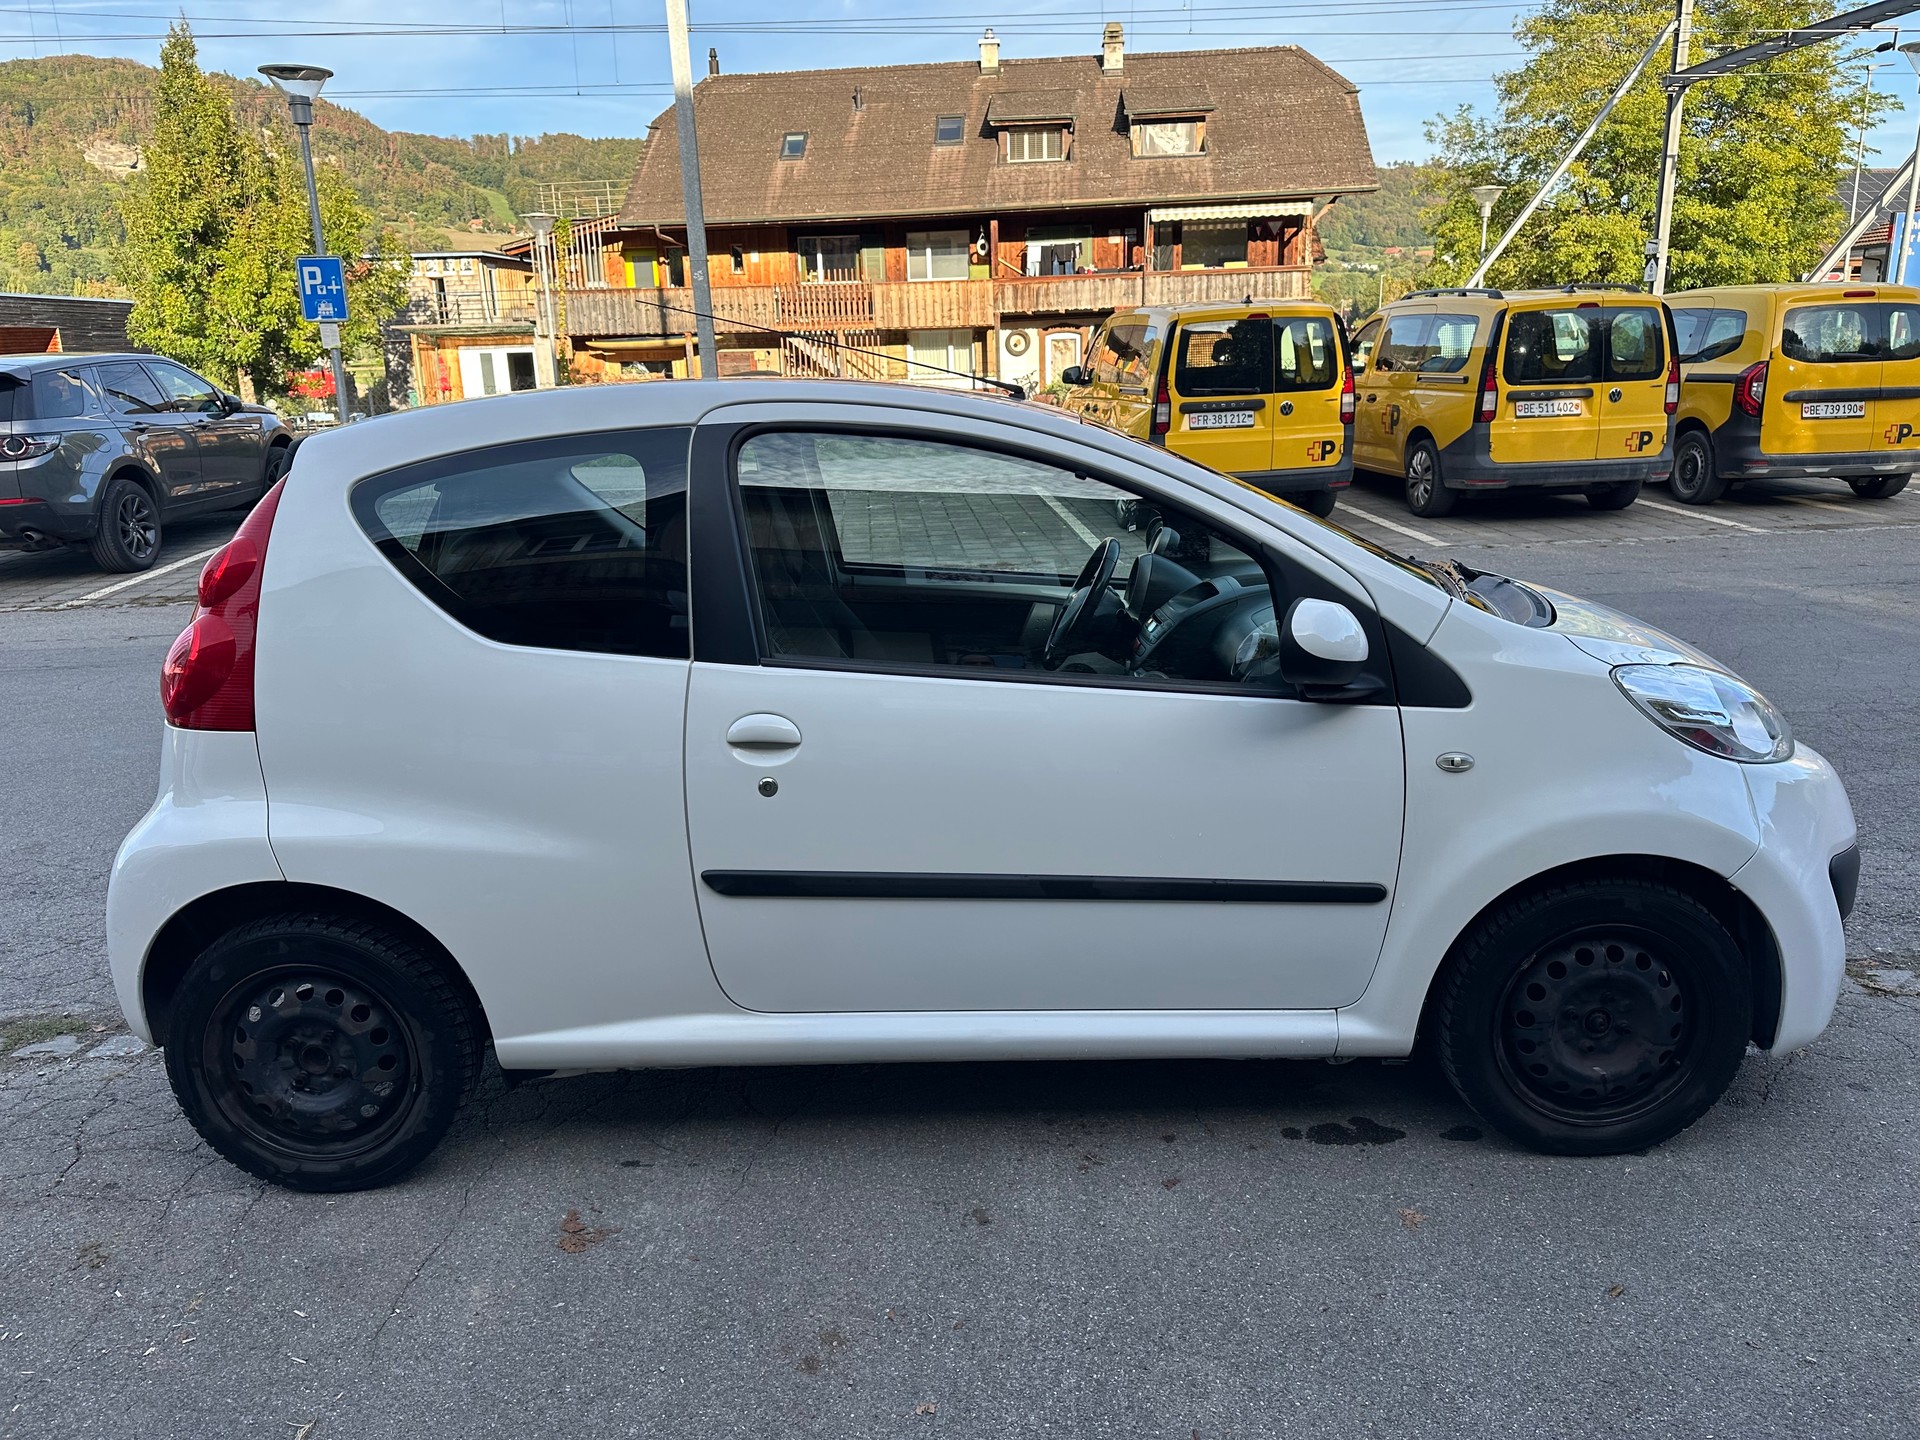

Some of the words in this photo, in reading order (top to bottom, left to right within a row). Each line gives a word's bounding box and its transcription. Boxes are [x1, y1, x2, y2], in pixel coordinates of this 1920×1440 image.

[302, 266, 322, 295] P
[1637, 431, 1654, 452] P
[1896, 424, 1913, 444] P
[1320, 440, 1336, 462] P
